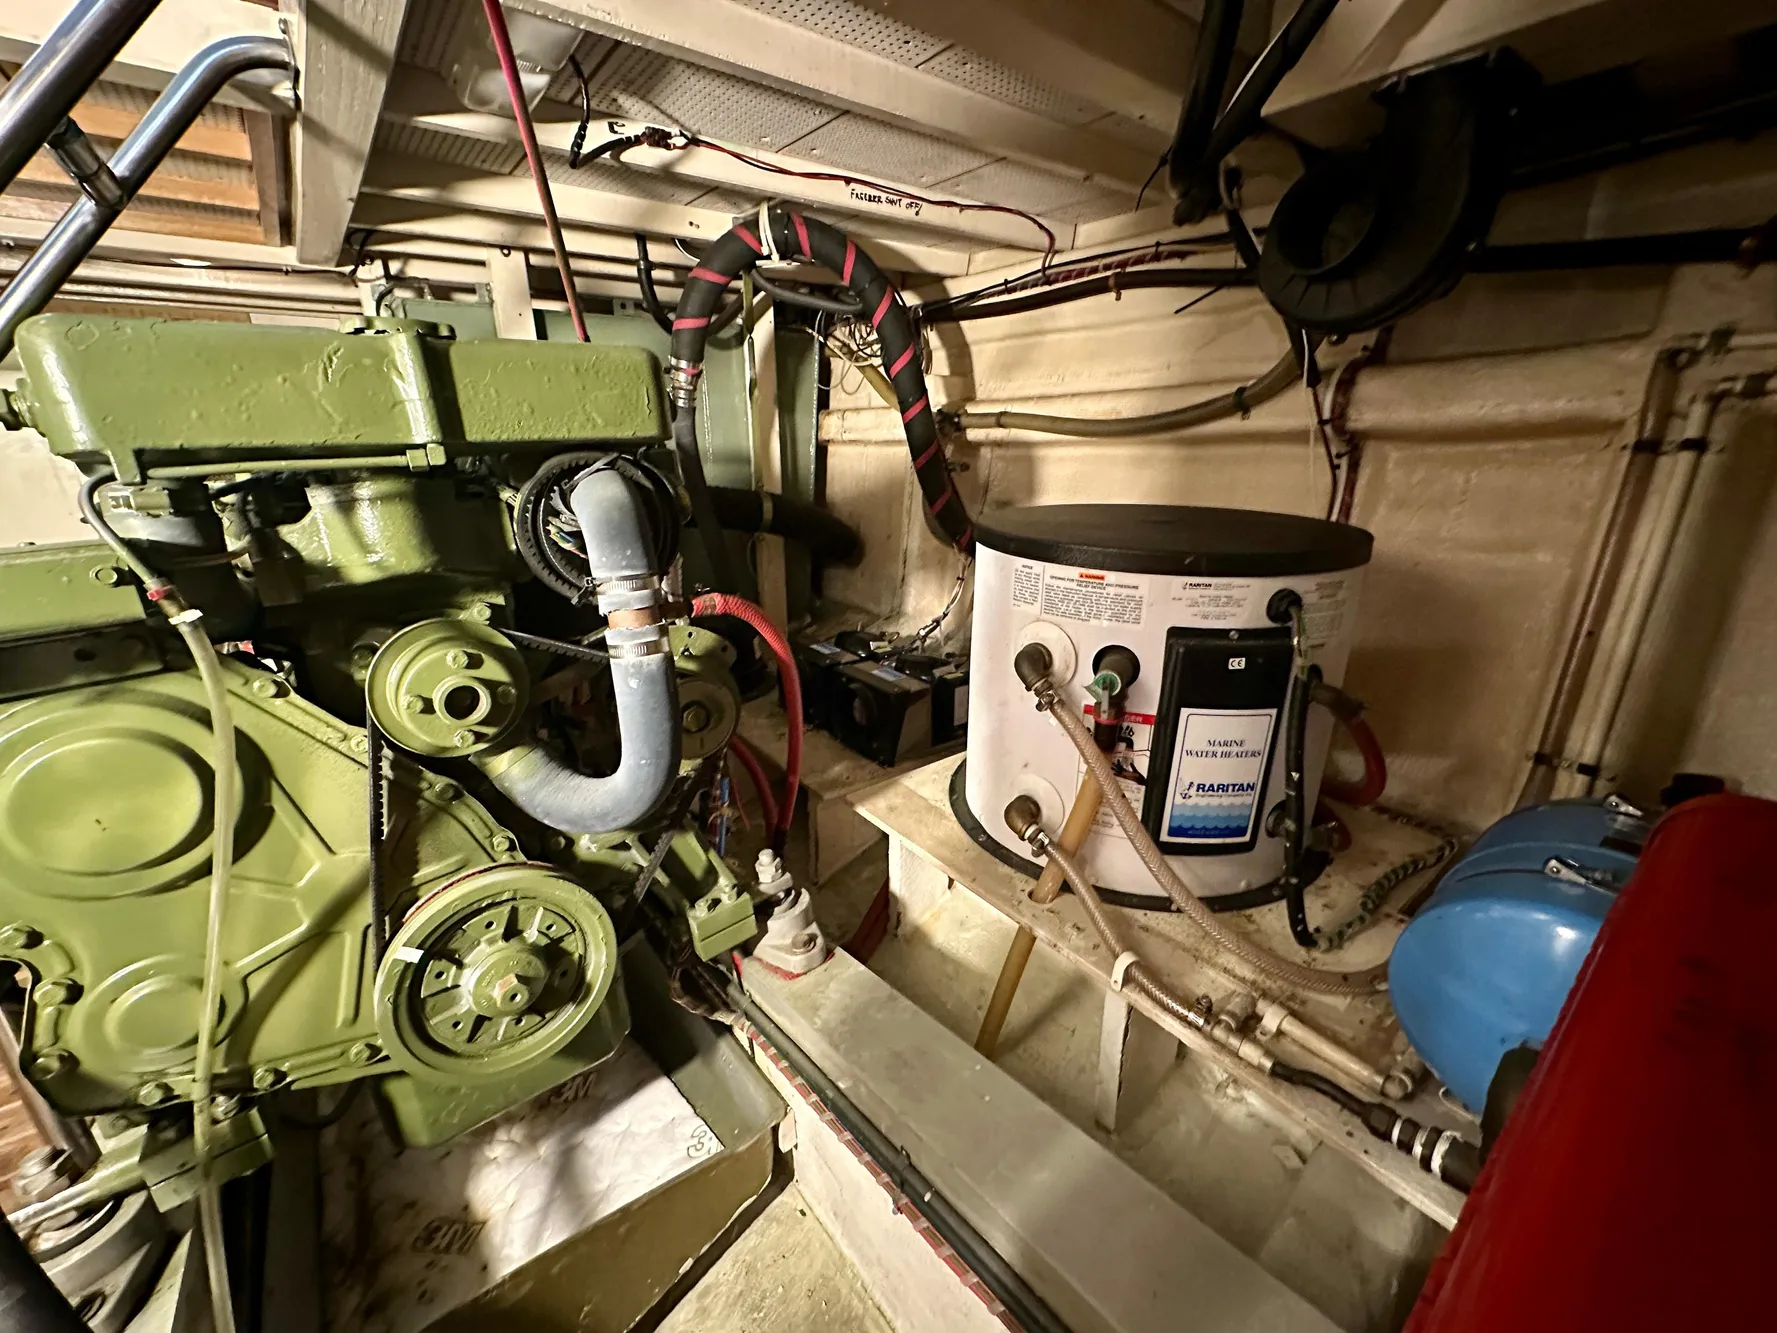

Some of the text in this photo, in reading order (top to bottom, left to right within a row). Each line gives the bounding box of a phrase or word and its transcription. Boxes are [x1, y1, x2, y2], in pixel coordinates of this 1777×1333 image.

[1185, 750, 1262, 758] WATER HEATERS
[1196, 783, 1255, 793] RARITAN
